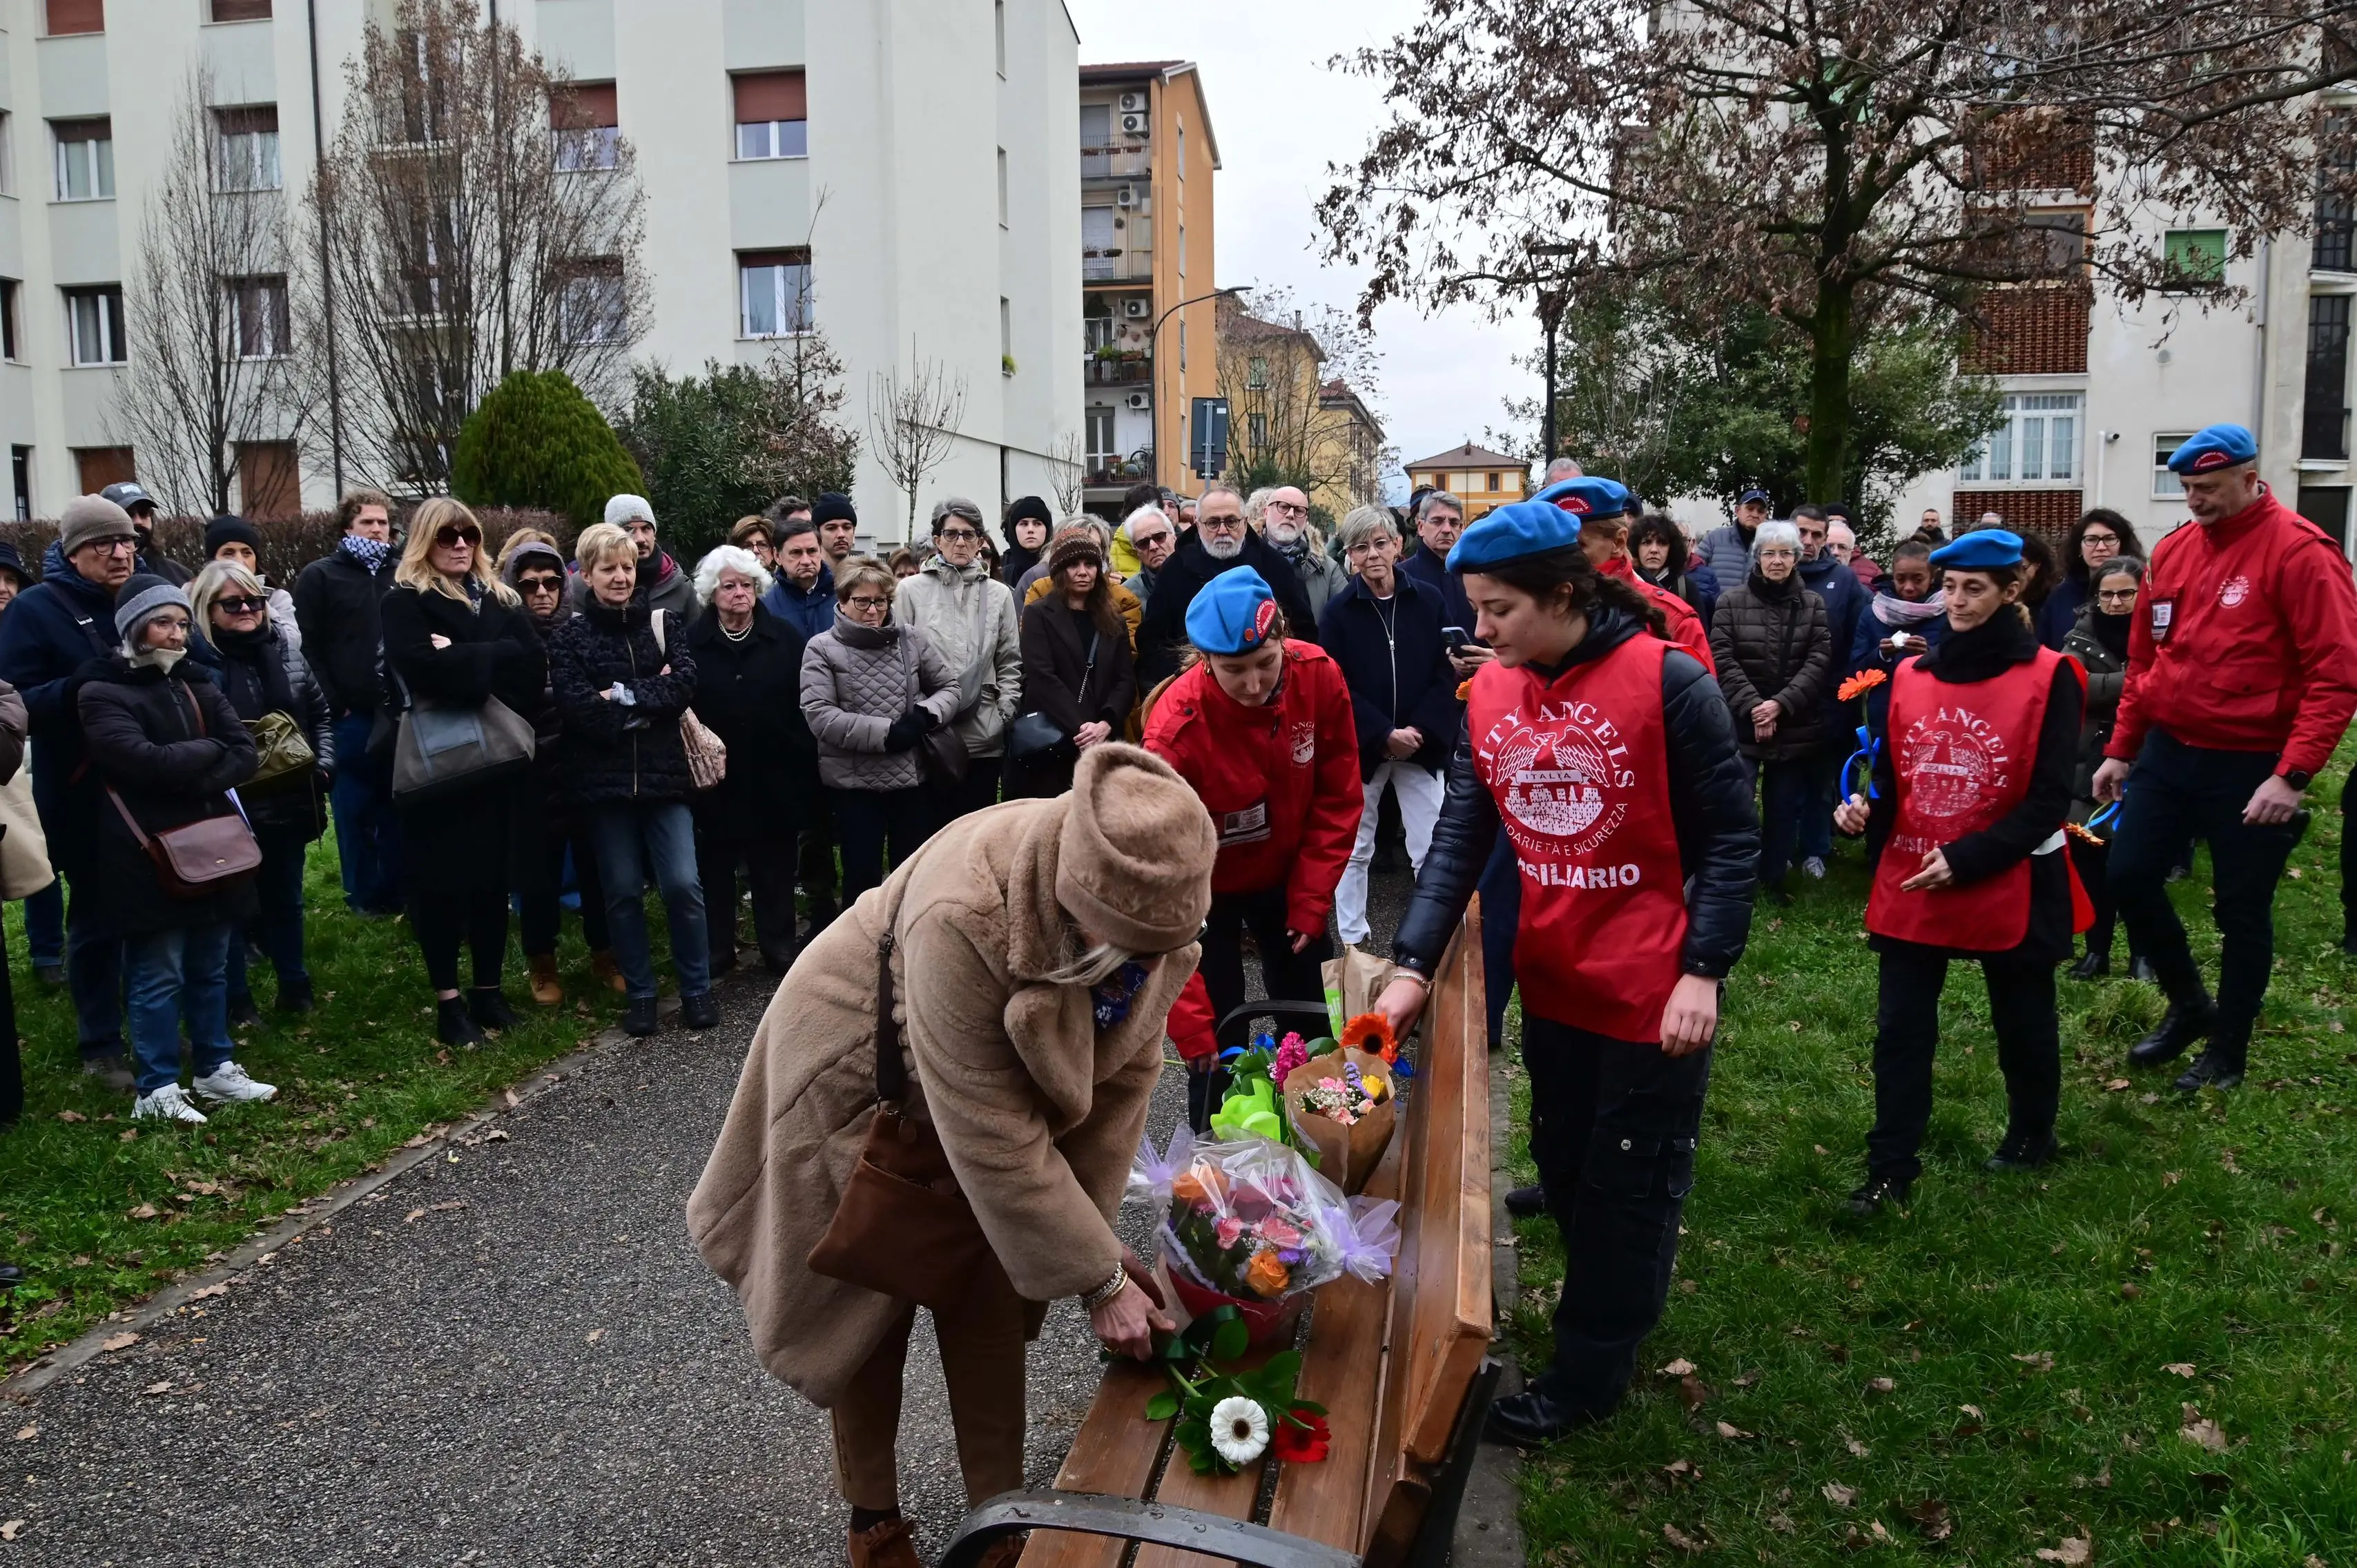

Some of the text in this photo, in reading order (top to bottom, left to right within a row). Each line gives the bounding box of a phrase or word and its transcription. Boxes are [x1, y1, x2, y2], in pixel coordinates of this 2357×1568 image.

[1535, 700, 1636, 788] ANGELS
[1900, 706, 2010, 788] CITY ANGELS
[1525, 772, 1572, 780] ITALIA
[1495, 800, 1629, 856] IDARIETÀ E SICUREZZA
[1517, 857, 1640, 889] SILIARIO
